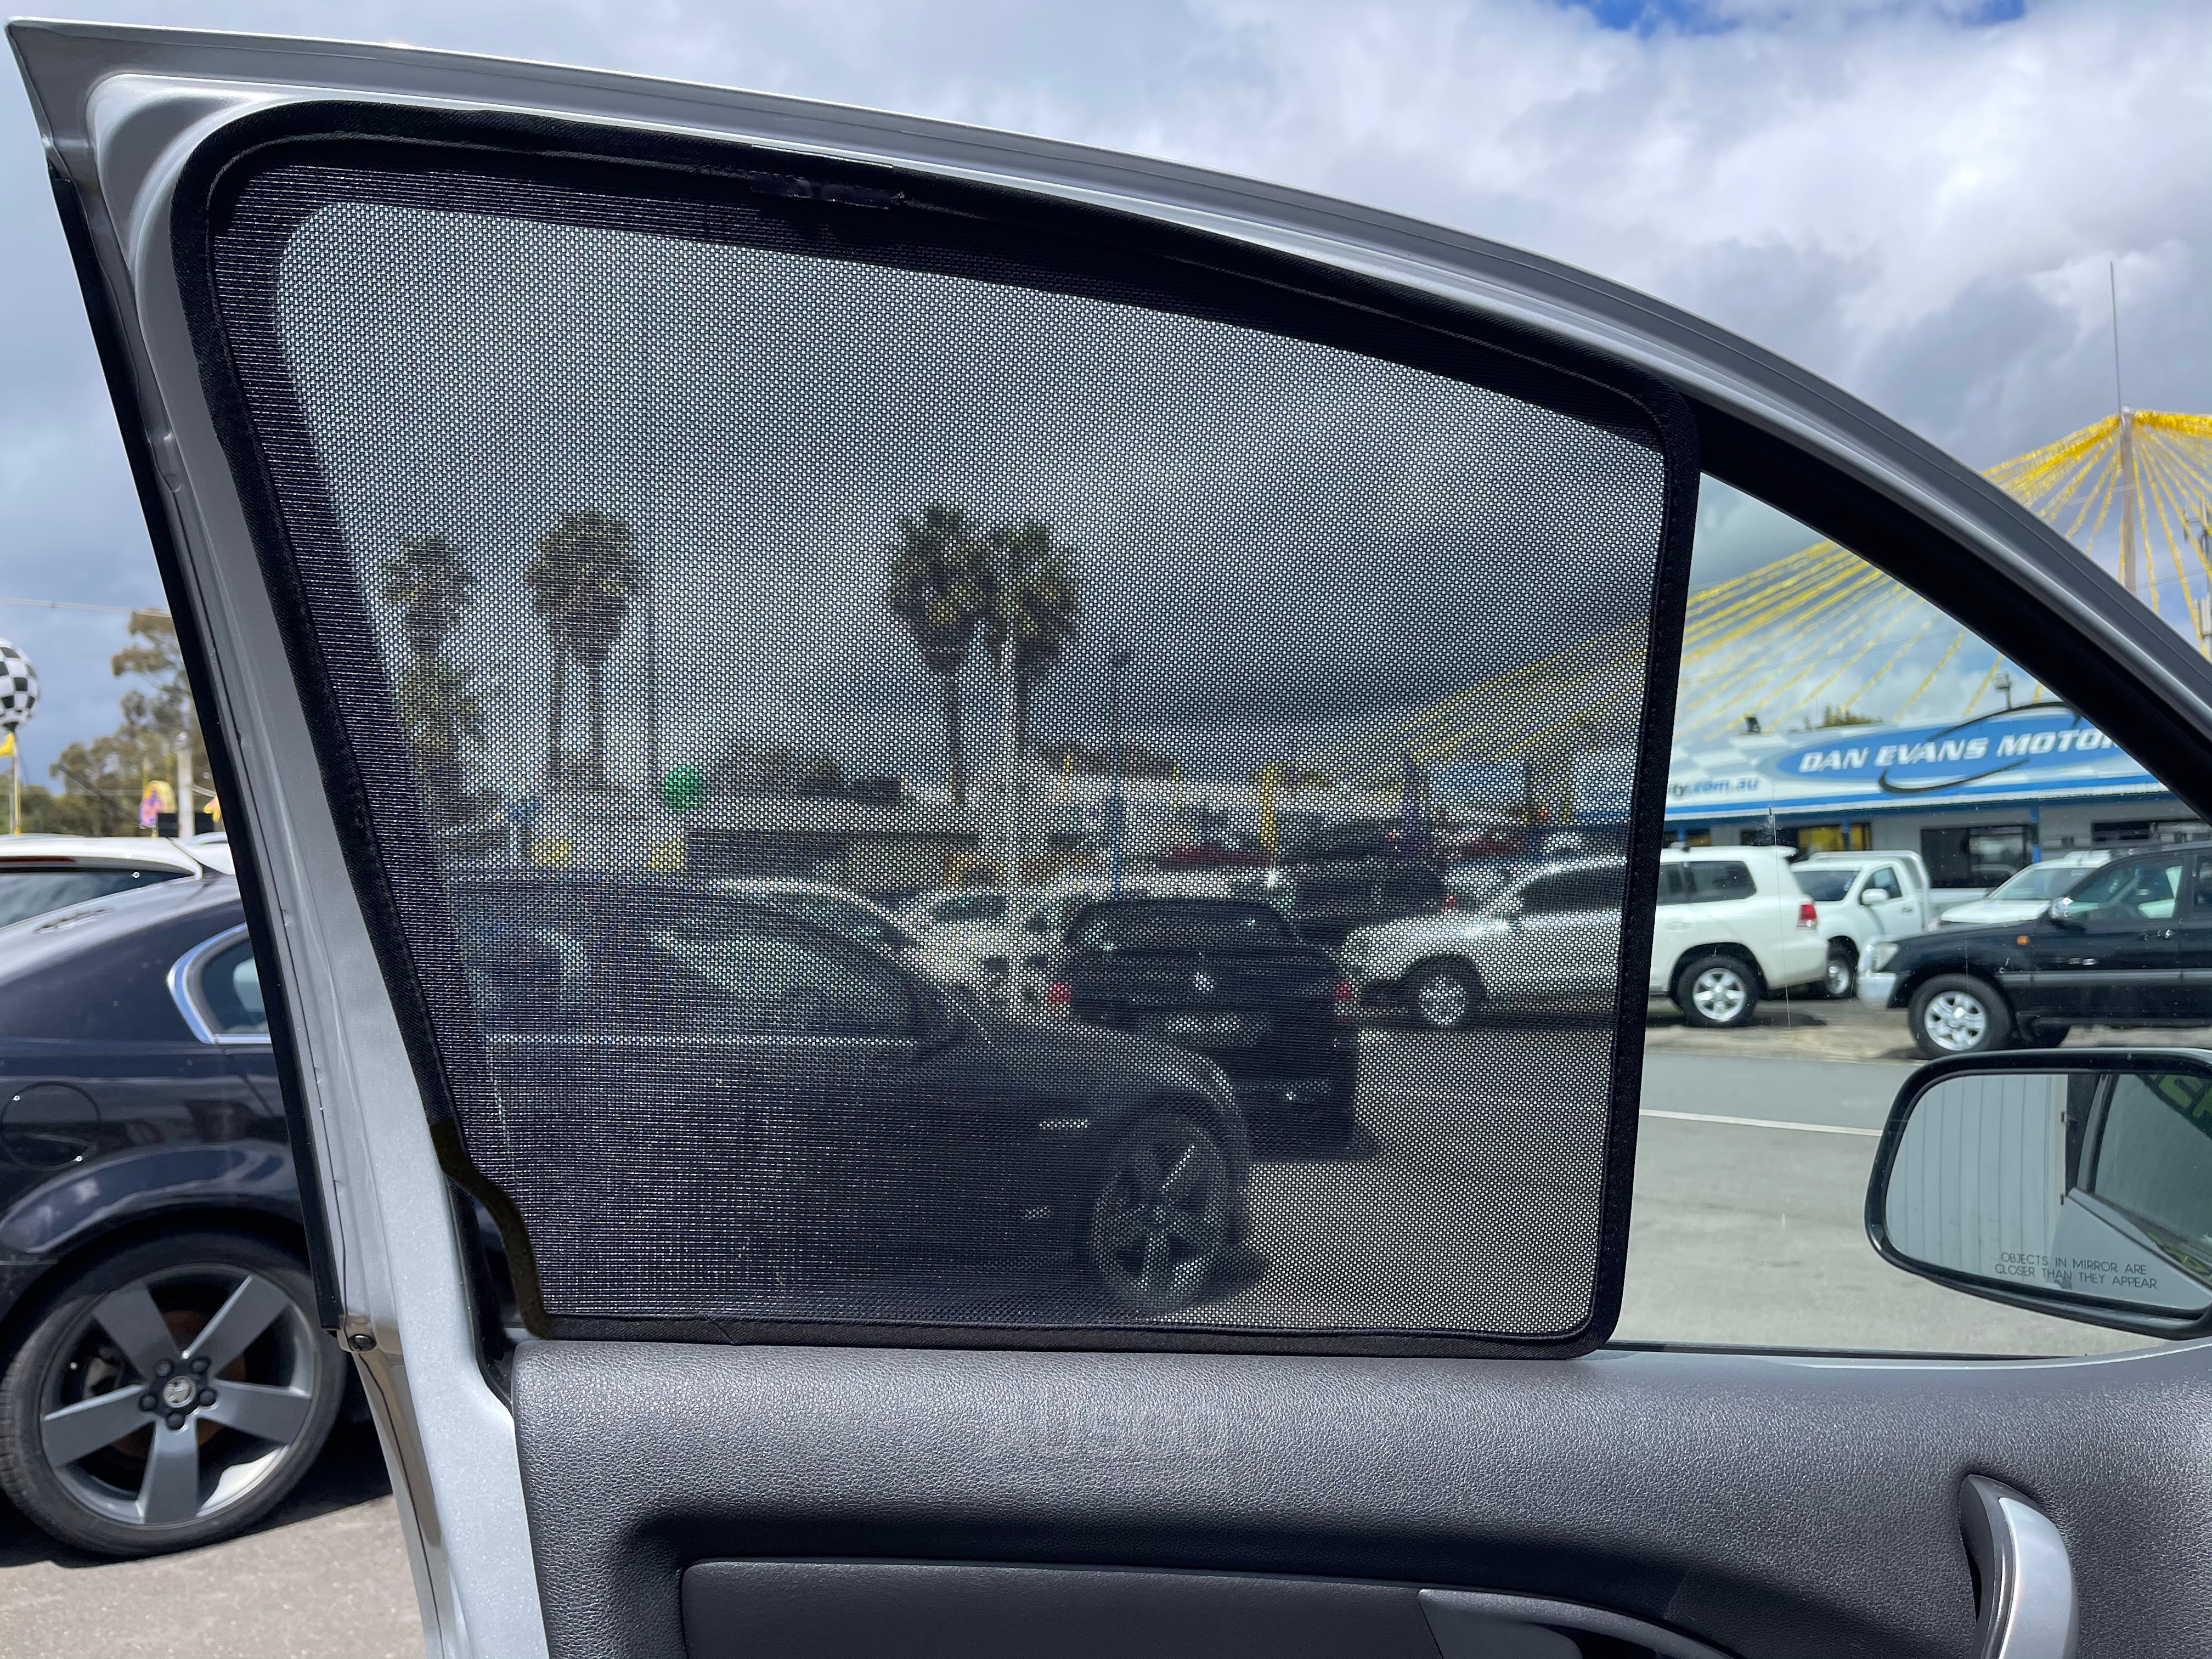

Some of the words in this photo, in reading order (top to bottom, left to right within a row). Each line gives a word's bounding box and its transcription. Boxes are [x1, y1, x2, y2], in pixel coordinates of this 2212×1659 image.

[1799, 748, 1868, 772] DAN
[1874, 737, 1989, 767] EVANS
[1995, 1263, 2035, 1277] CLOSER
[2041, 1267, 2072, 1280] THAN
[2078, 1272, 2106, 1284] THEY
[2112, 1276, 2157, 1289] APPEAR
[2001, 1252, 2048, 1265] OBJECTS
[2055, 1257, 2067, 1268] IN
[2073, 1259, 2118, 1272] MIRROR
[2124, 1264, 2147, 1276] ARE
